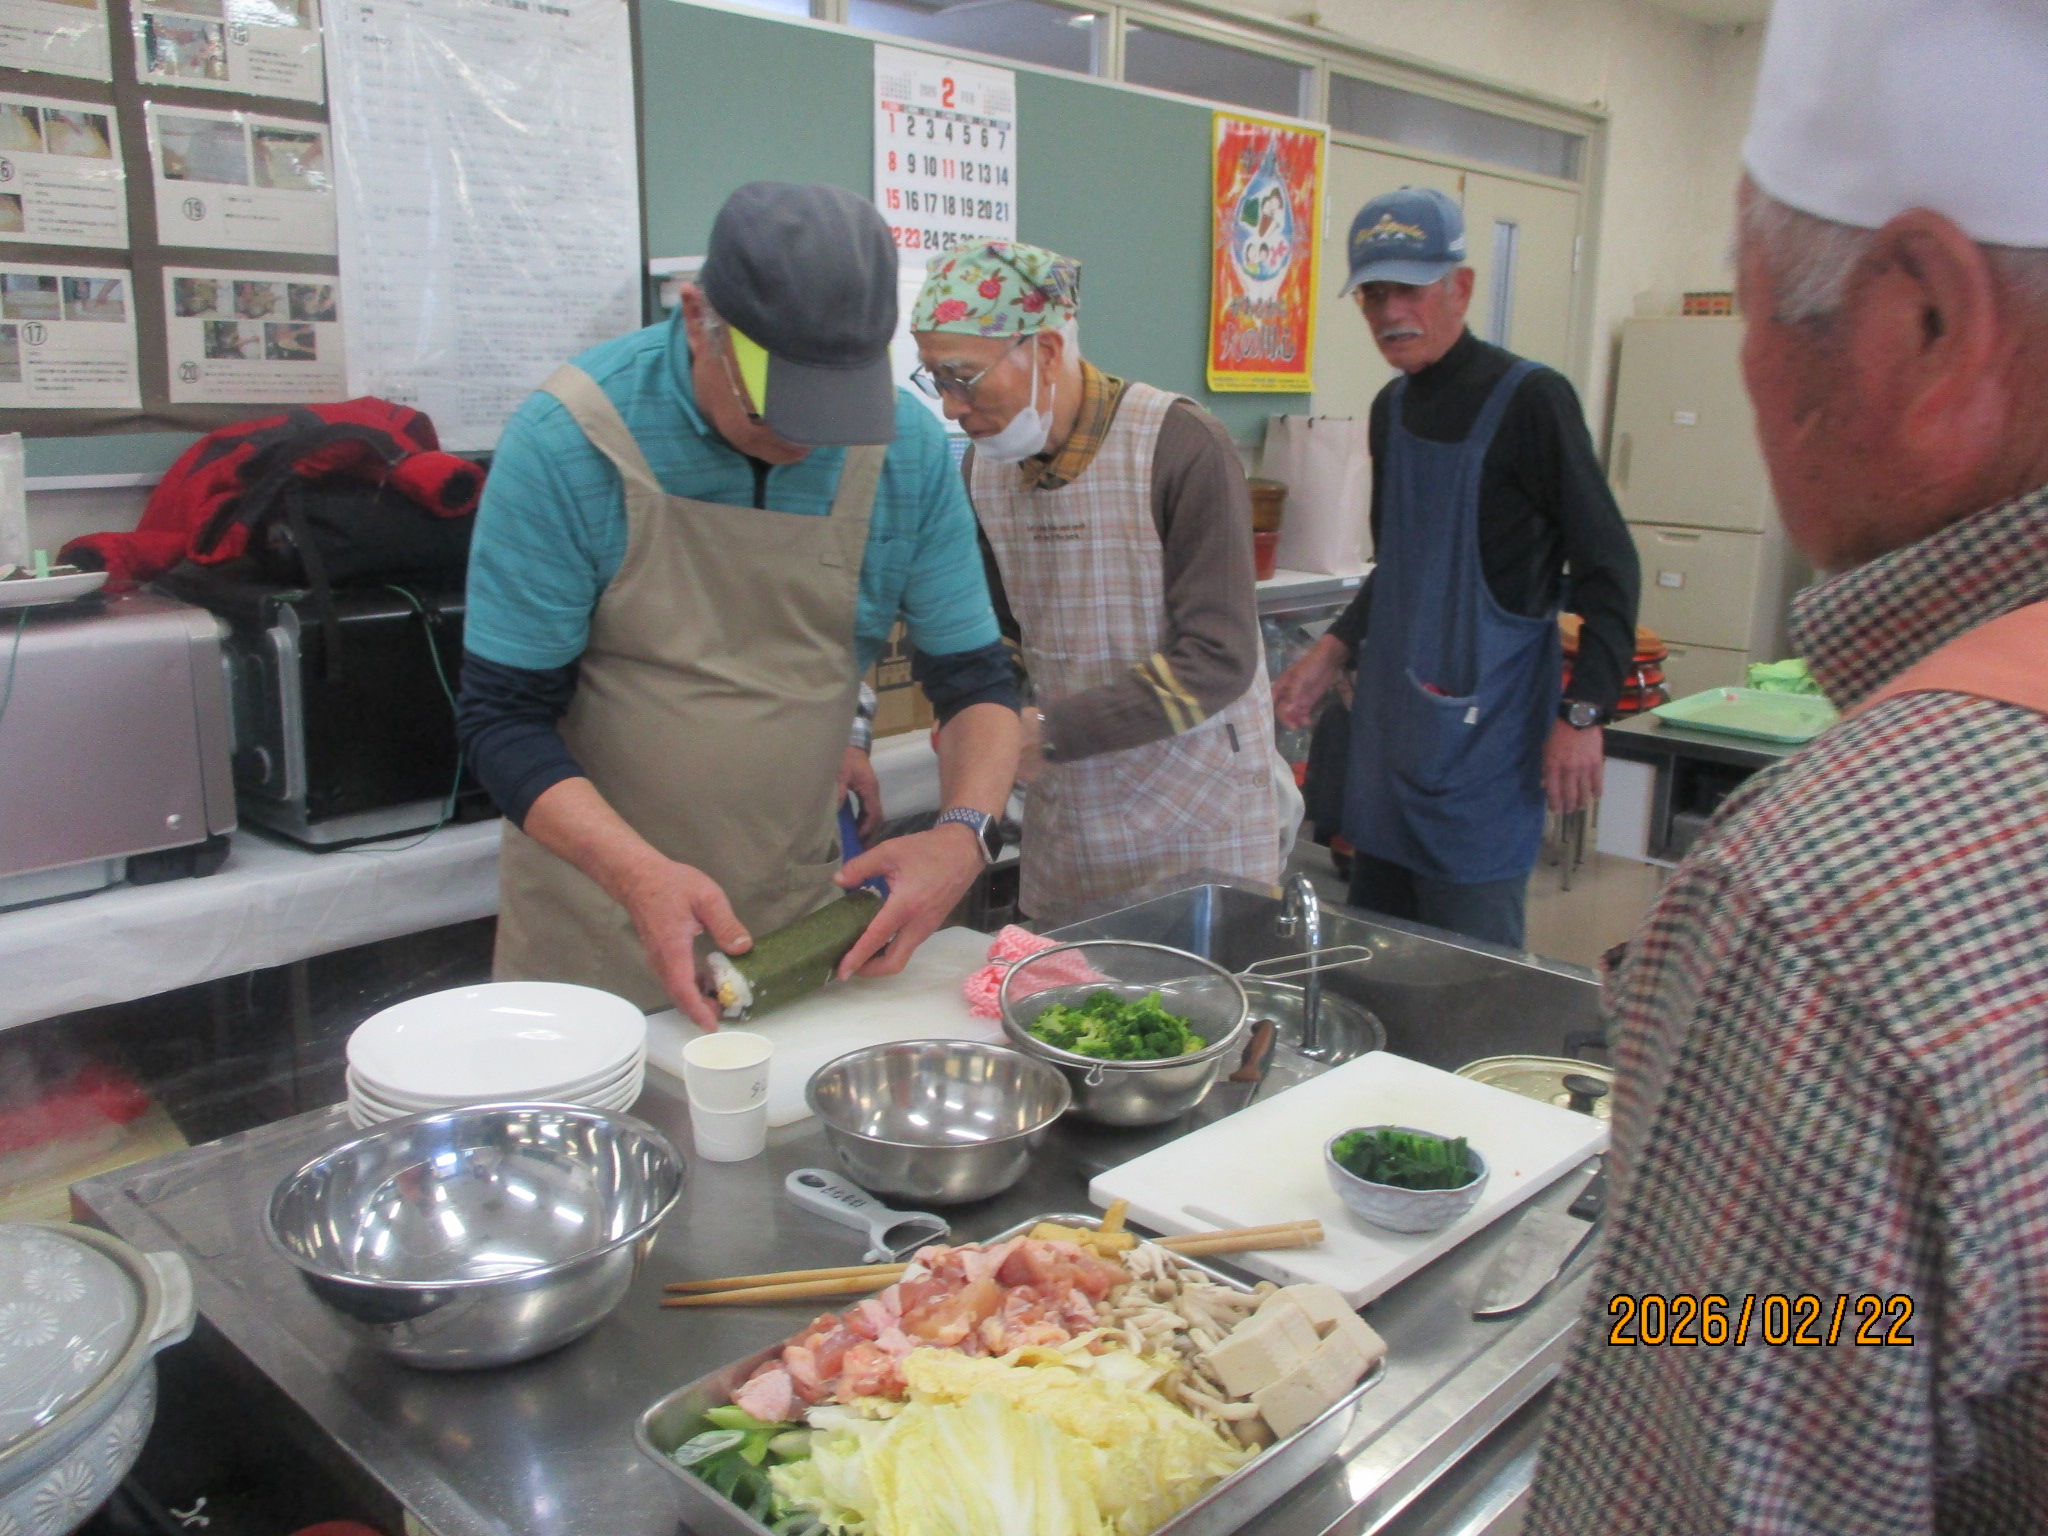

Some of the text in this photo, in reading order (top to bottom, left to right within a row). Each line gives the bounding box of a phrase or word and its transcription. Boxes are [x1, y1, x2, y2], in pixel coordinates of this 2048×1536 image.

[941, 77, 955, 108] 2
[889, 113, 895, 134] 1
[908, 116, 915, 136] 2
[926, 118, 934, 139] 3
[945, 122, 953, 142] 4
[963, 125, 971, 145] 5
[981, 128, 988, 148] 6
[998, 130, 1005, 150] 7
[888, 150, 1008, 186] 8 9 10 11 12 13 14
[886, 188, 1008, 221] 15 16 17 18 19 20 21
[904, 228, 920, 248] 23
[924, 230, 939, 250] 24
